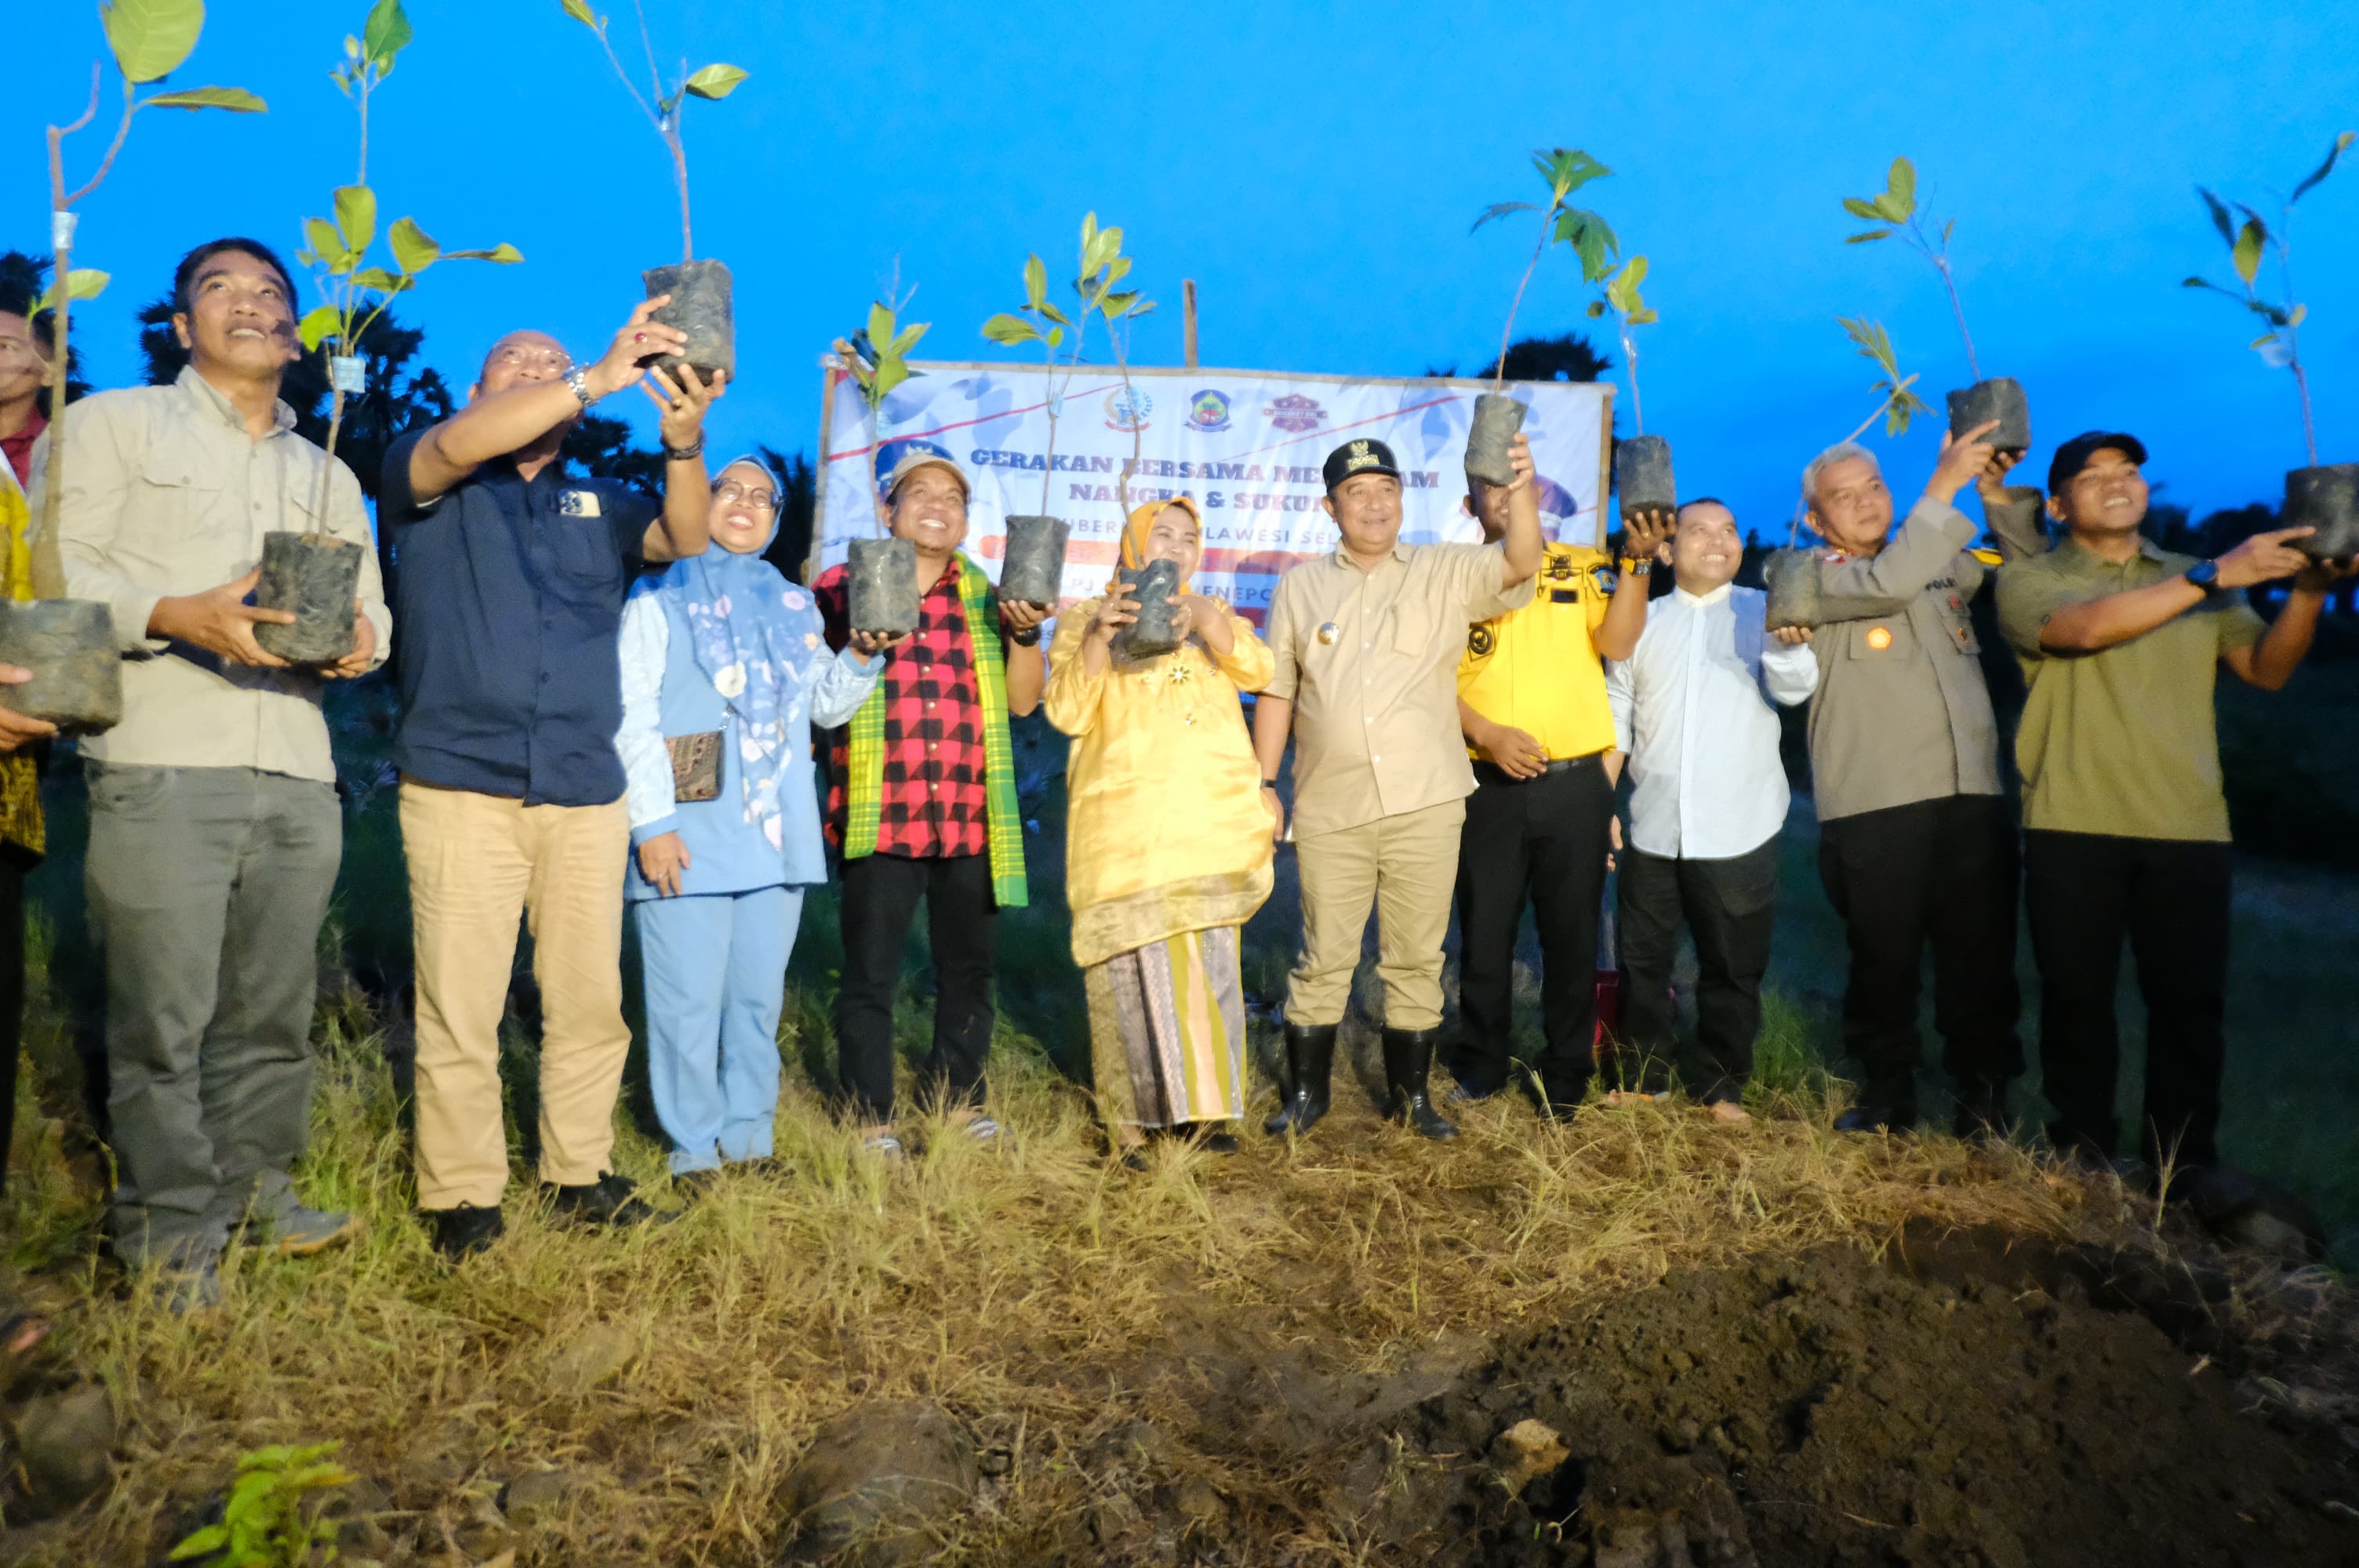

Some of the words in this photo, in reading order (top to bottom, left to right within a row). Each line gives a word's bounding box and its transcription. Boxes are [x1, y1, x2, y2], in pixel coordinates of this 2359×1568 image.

[971, 448, 1114, 474] GERAKAN
[1122, 458, 1265, 481] BERSAMA
[1206, 491, 1225, 508] &
